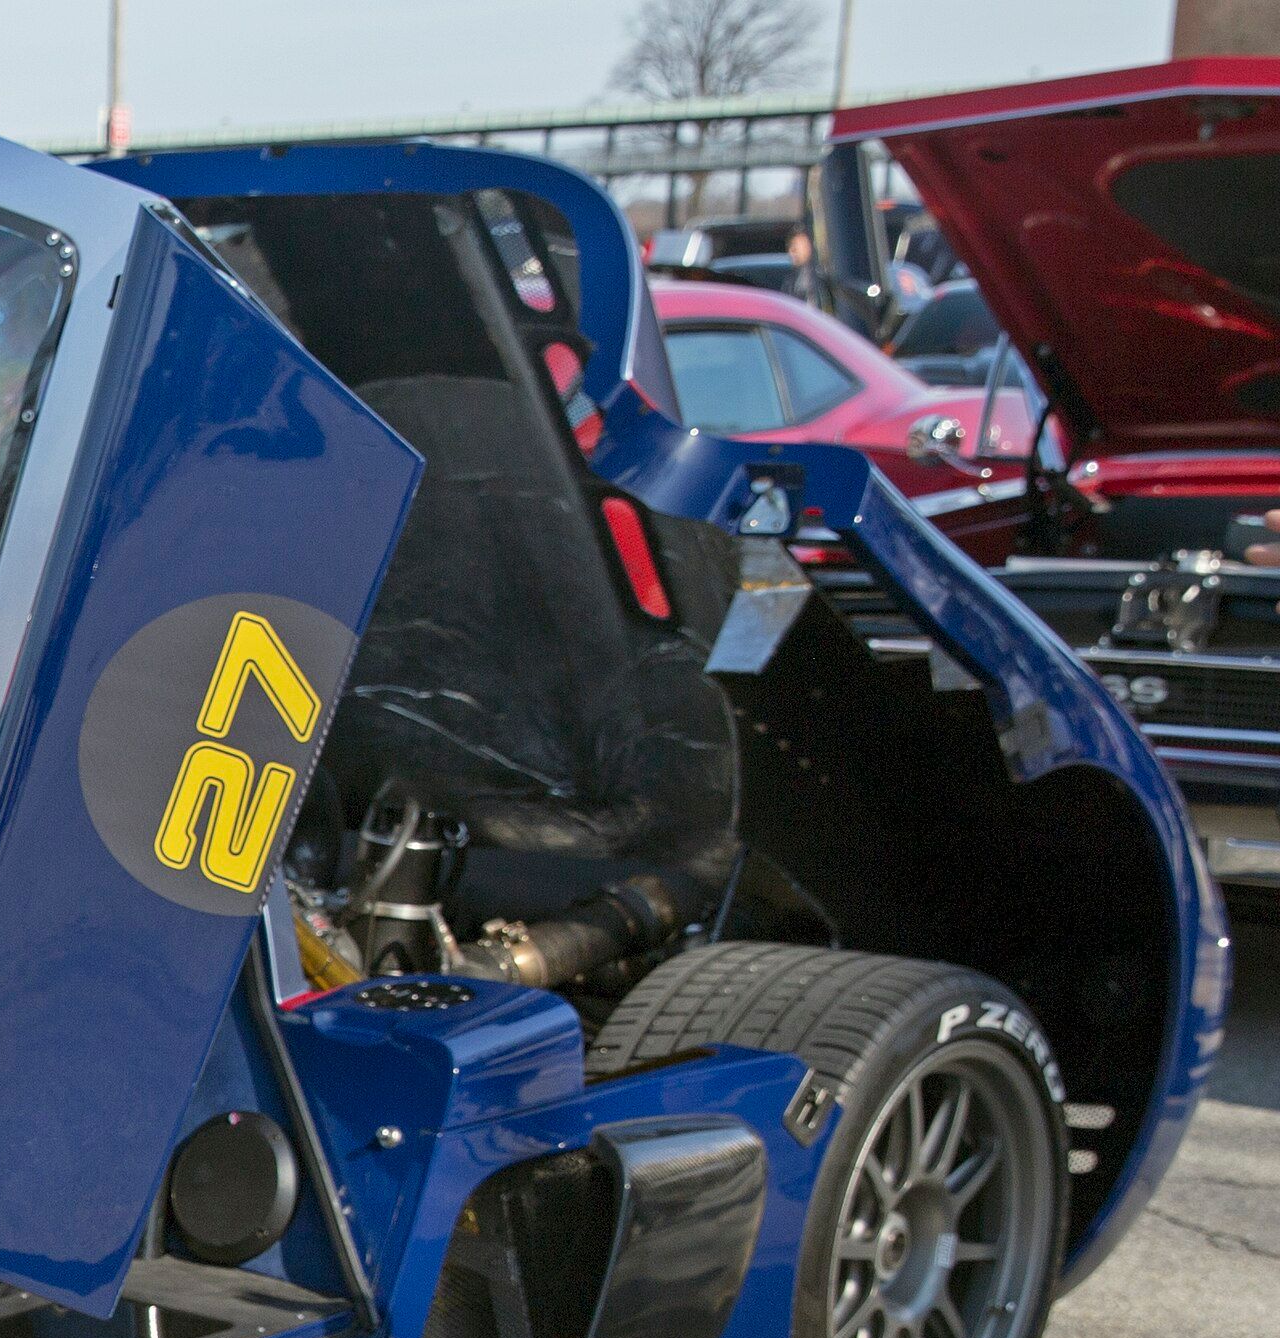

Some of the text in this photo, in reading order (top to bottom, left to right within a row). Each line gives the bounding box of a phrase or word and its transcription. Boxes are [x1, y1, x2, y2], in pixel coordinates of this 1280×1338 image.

[154, 611, 321, 893] 27
[937, 1001, 1066, 1102] P ZERO
